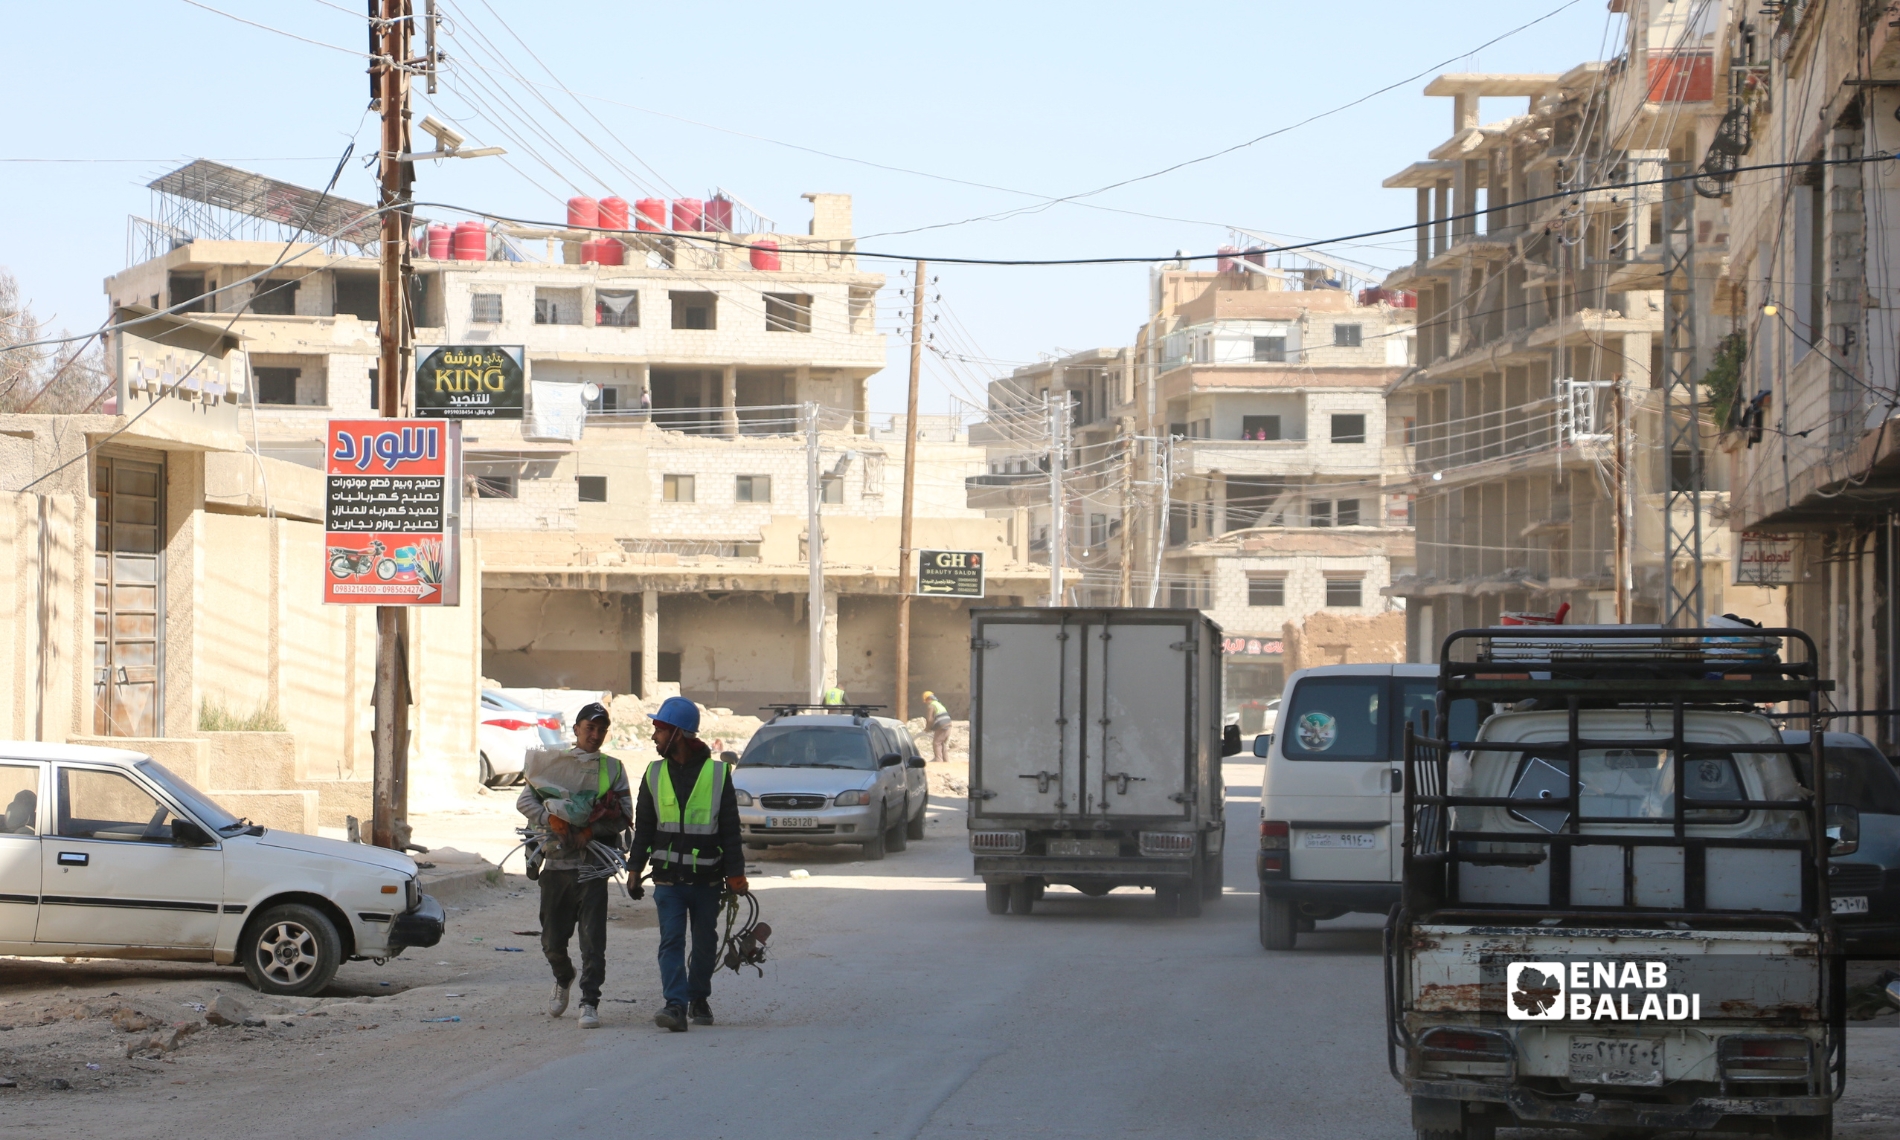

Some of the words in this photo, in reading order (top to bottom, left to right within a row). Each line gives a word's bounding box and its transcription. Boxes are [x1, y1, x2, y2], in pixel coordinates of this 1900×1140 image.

[444, 351, 482, 367] ورشة
[435, 368, 506, 392] KING
[449, 393, 490, 407] للتنجيد
[333, 427, 438, 471] اللورد
[331, 478, 368, 489] موتورات
[369, 477, 390, 490] قطع
[392, 479, 413, 490] وبيع
[415, 479, 441, 490] تصليح
[331, 491, 399, 503] كهربائيات
[401, 492, 440, 504] تصليح
[331, 505, 367, 516] للمنازل
[368, 505, 407, 517] كهرباء
[408, 505, 439, 517] تمديد
[331, 519, 374, 530] نجارين
[375, 519, 401, 530] لوازم
[402, 519, 439, 532] تصليح
[936, 553, 966, 568] GH
[335, 585, 377, 593] 0983214300
[382, 585, 424, 594] 0985624274
[771, 817, 778, 827] B
[782, 817, 813, 827] 653120
[1341, 834, 1373, 846] ٩٩١٤٠٠
[1571, 1053, 1594, 1063] SYR
